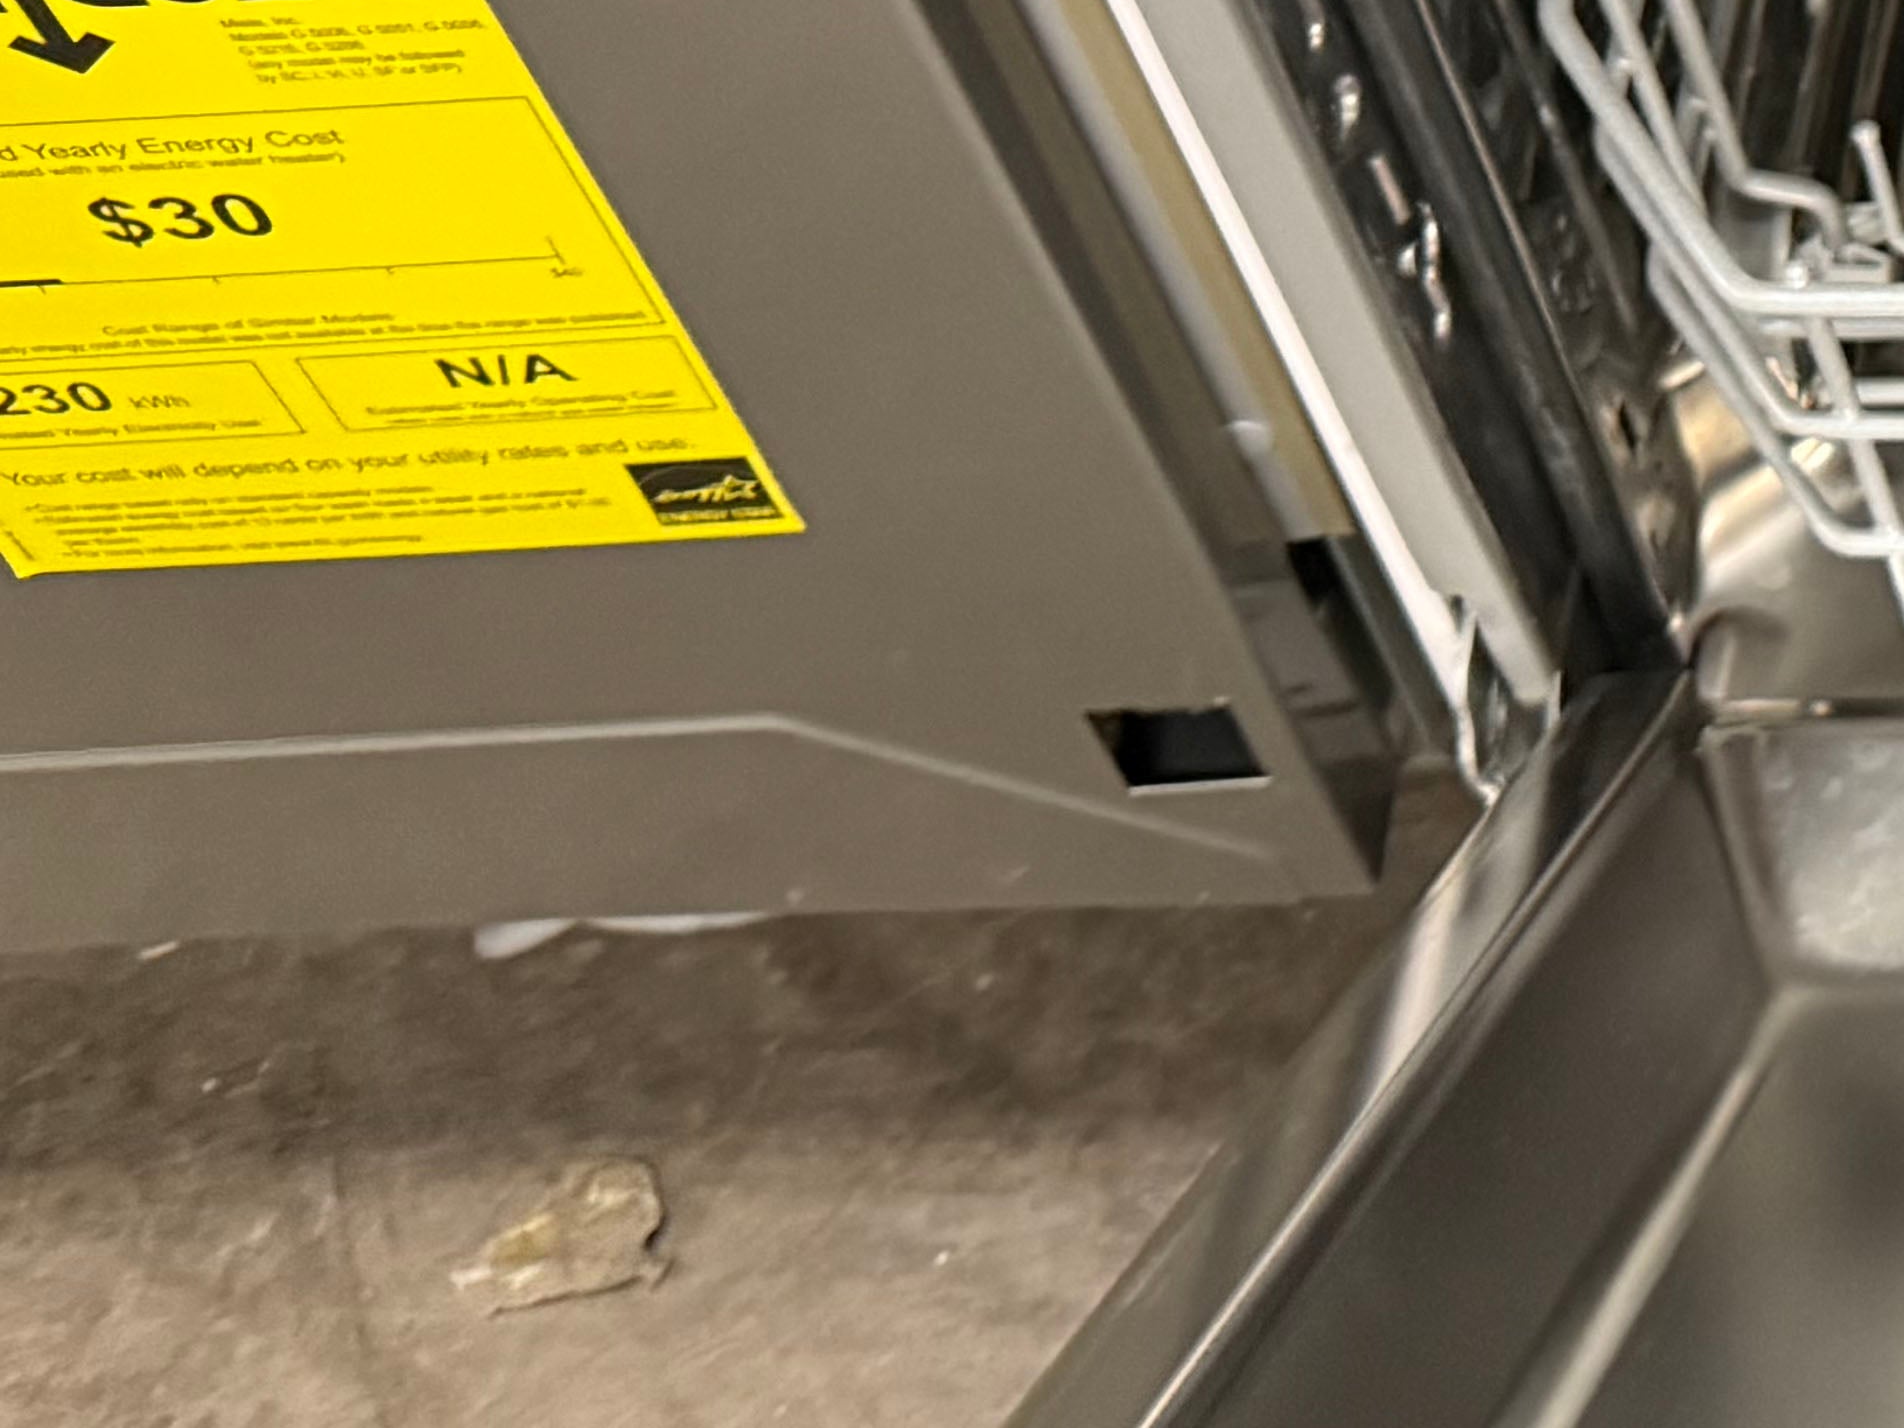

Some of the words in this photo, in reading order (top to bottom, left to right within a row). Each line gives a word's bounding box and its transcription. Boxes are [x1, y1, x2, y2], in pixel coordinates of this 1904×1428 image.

[21, 141, 128, 161] Yearly
[136, 136, 254, 154] Energy
[264, 128, 347, 149] Cost
[87, 192, 274, 249] $30
[433, 353, 580, 389] N/A
[0, 380, 113, 416] 230
